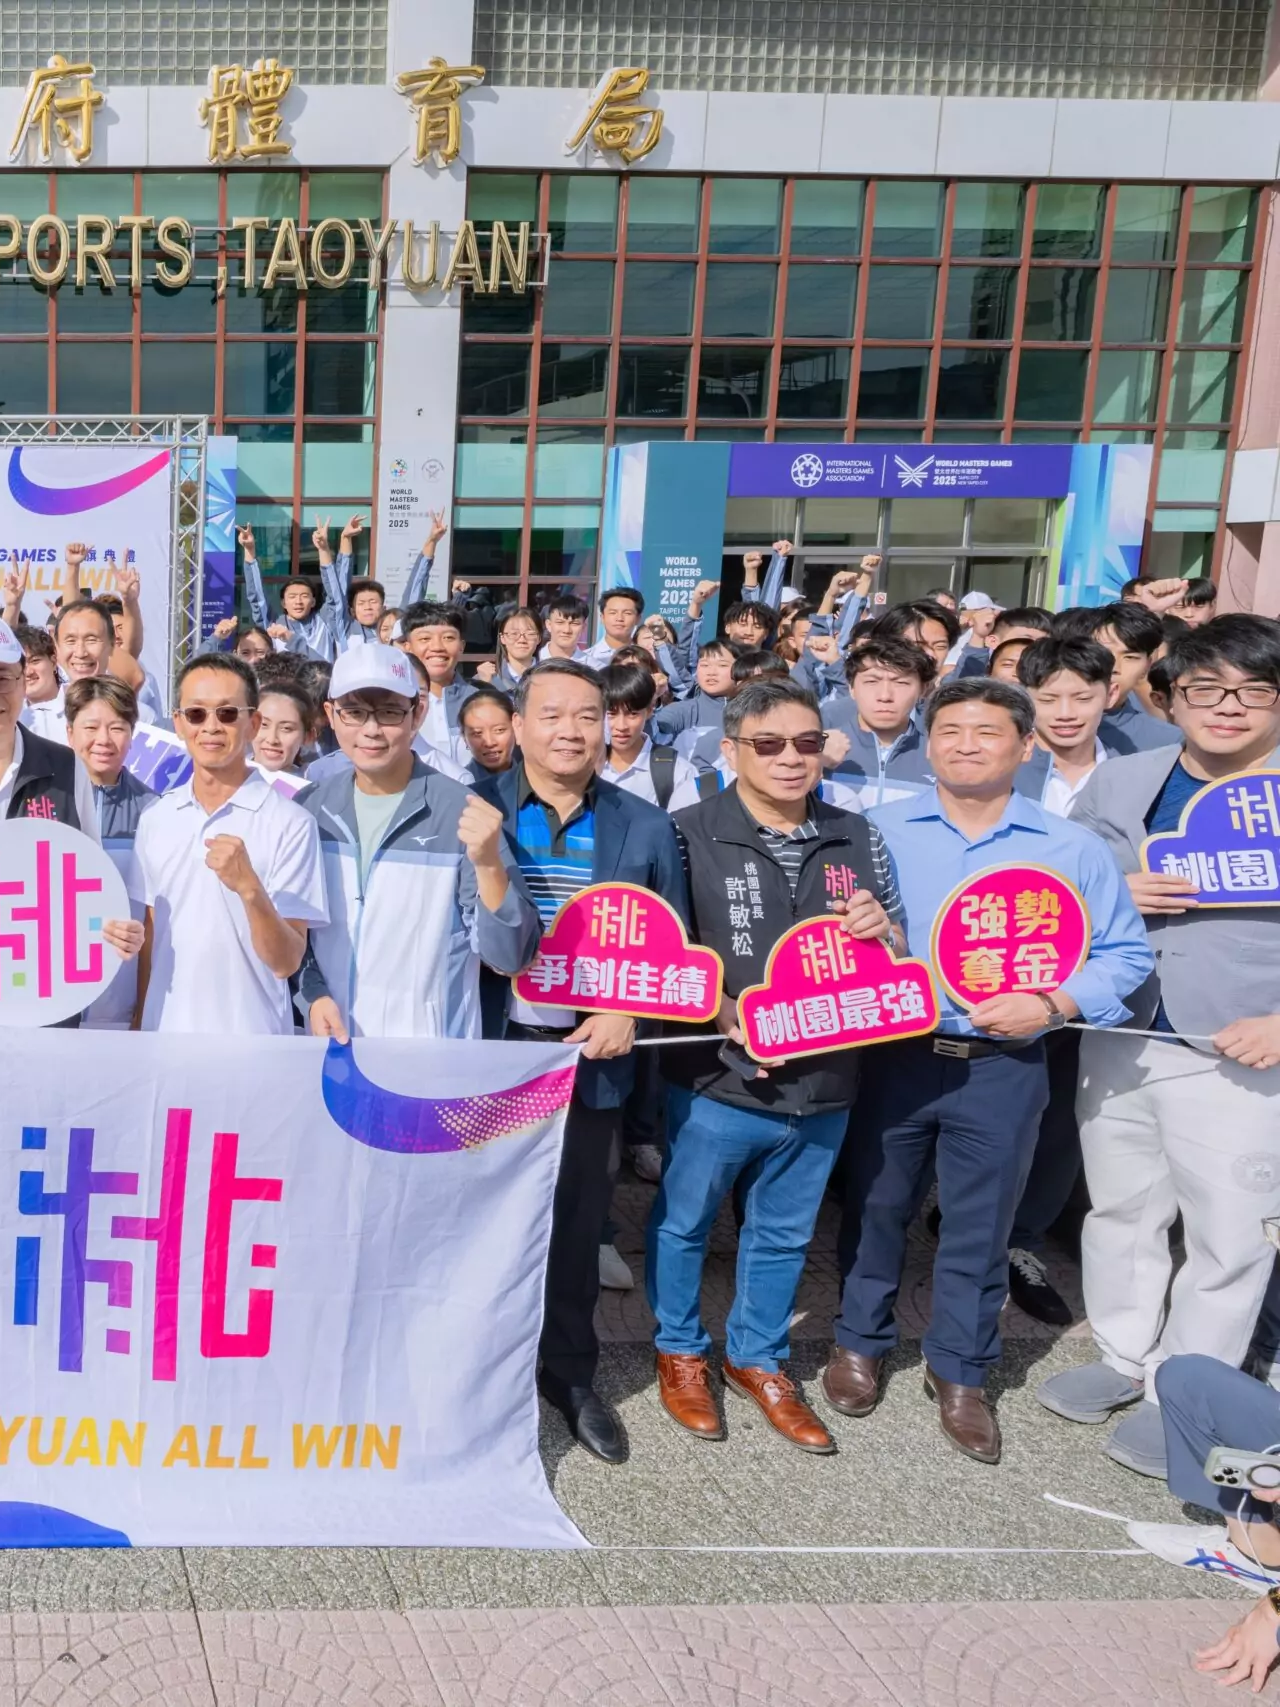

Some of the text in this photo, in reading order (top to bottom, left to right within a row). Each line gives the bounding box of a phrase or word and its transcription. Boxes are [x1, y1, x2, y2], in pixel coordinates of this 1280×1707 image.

[825, 467, 875, 475] MASTERS GAMES
[826, 460, 873, 468] INTERNATIONAL
[933, 476, 957, 486] 2025
[388, 519, 409, 528] 2025
[659, 567, 702, 577] MASTERS
[665, 556, 698, 566] WORLD
[664, 579, 695, 588] GAMES
[744, 862, 765, 920] 桃園區長
[724, 876, 754, 957] 許敏松
[959, 888, 1062, 941] 強勢
[527, 954, 708, 1009] 爭創佳績
[958, 943, 1061, 993] 奪金
[753, 979, 927, 1047] 桃園最強
[163, 1423, 270, 1470] ALL
[290, 1422, 404, 1471] WIN
